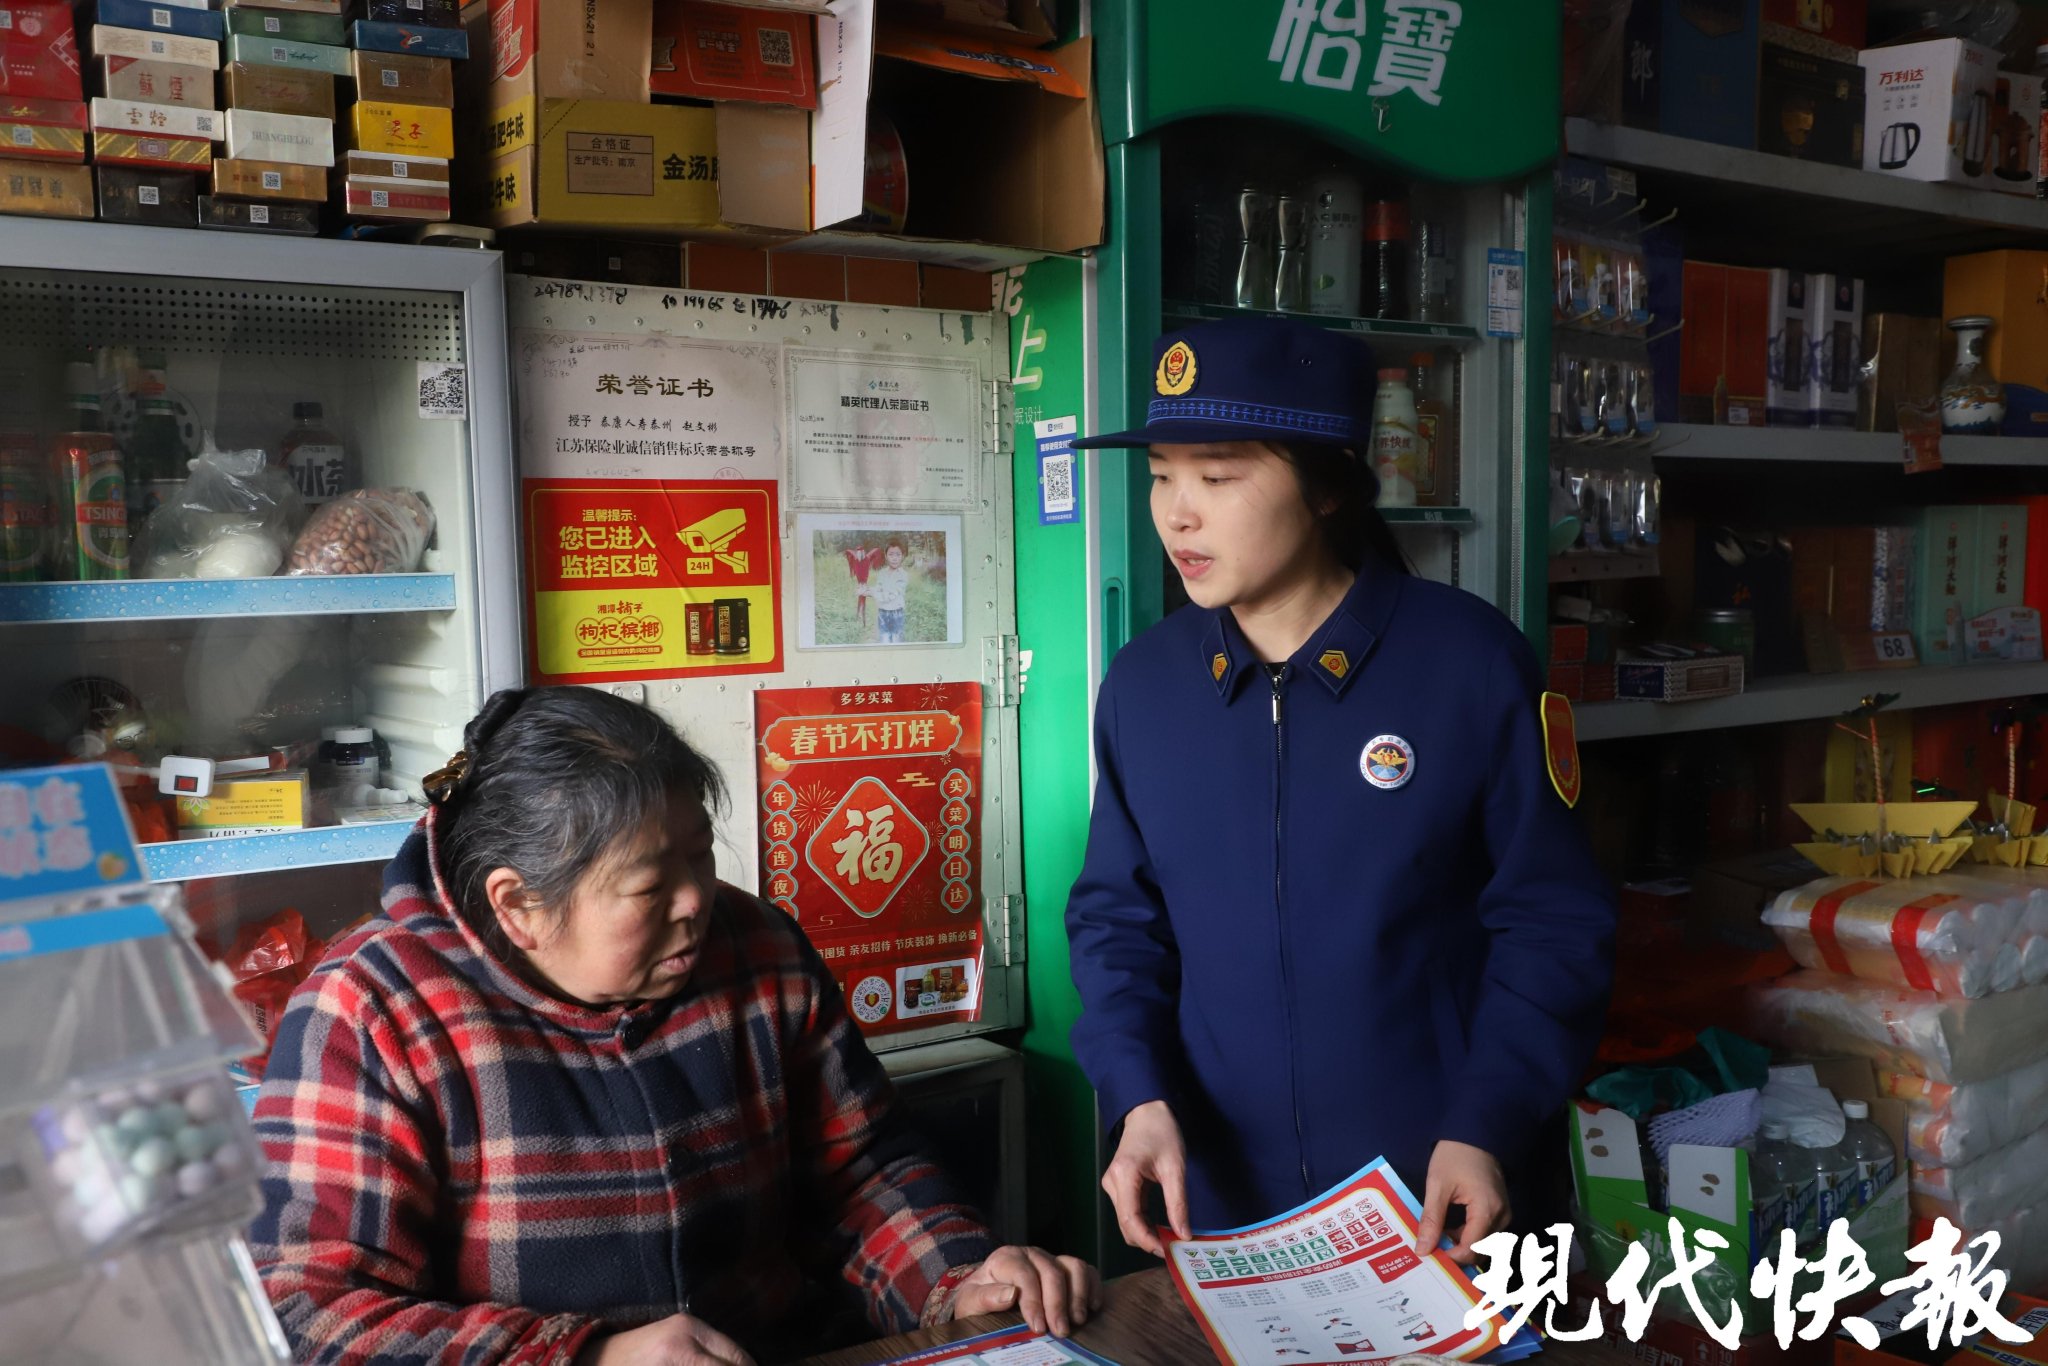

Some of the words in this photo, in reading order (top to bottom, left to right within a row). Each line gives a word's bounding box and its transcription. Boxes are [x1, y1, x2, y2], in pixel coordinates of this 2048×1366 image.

[1879, 69, 1925, 86] 万利达
[590, 136, 631, 151] 合格证
[1011, 314, 1042, 385] 上
[596, 373, 714, 399] 荣誉证书
[840, 395, 930, 412] 精英代理人荣誉证书
[567, 413, 592, 428] 授予
[600, 415, 672, 432] 泰康人寿泰州
[555, 437, 757, 458] 江苏保险业诚信销售标兵荣誉称号
[582, 508, 637, 522] 温馨提示:
[559, 525, 657, 551] 您已进入
[559, 554, 659, 579] 监控区域
[690, 561, 710, 571] 24H
[579, 621, 660, 641] 枸杞槟榔
[1883, 638, 1905, 658] 68
[840, 691, 894, 706] 多多买菜
[790, 719, 936, 755] 春节不打烊
[832, 804, 904, 886] 福
[948, 777, 964, 904] 买菜明日达
[771, 790, 790, 913] 年货连夜
[849, 940, 891, 957] 亲友招待
[894, 934, 935, 951] 节庆装饰
[938, 929, 978, 945] 换新必备
